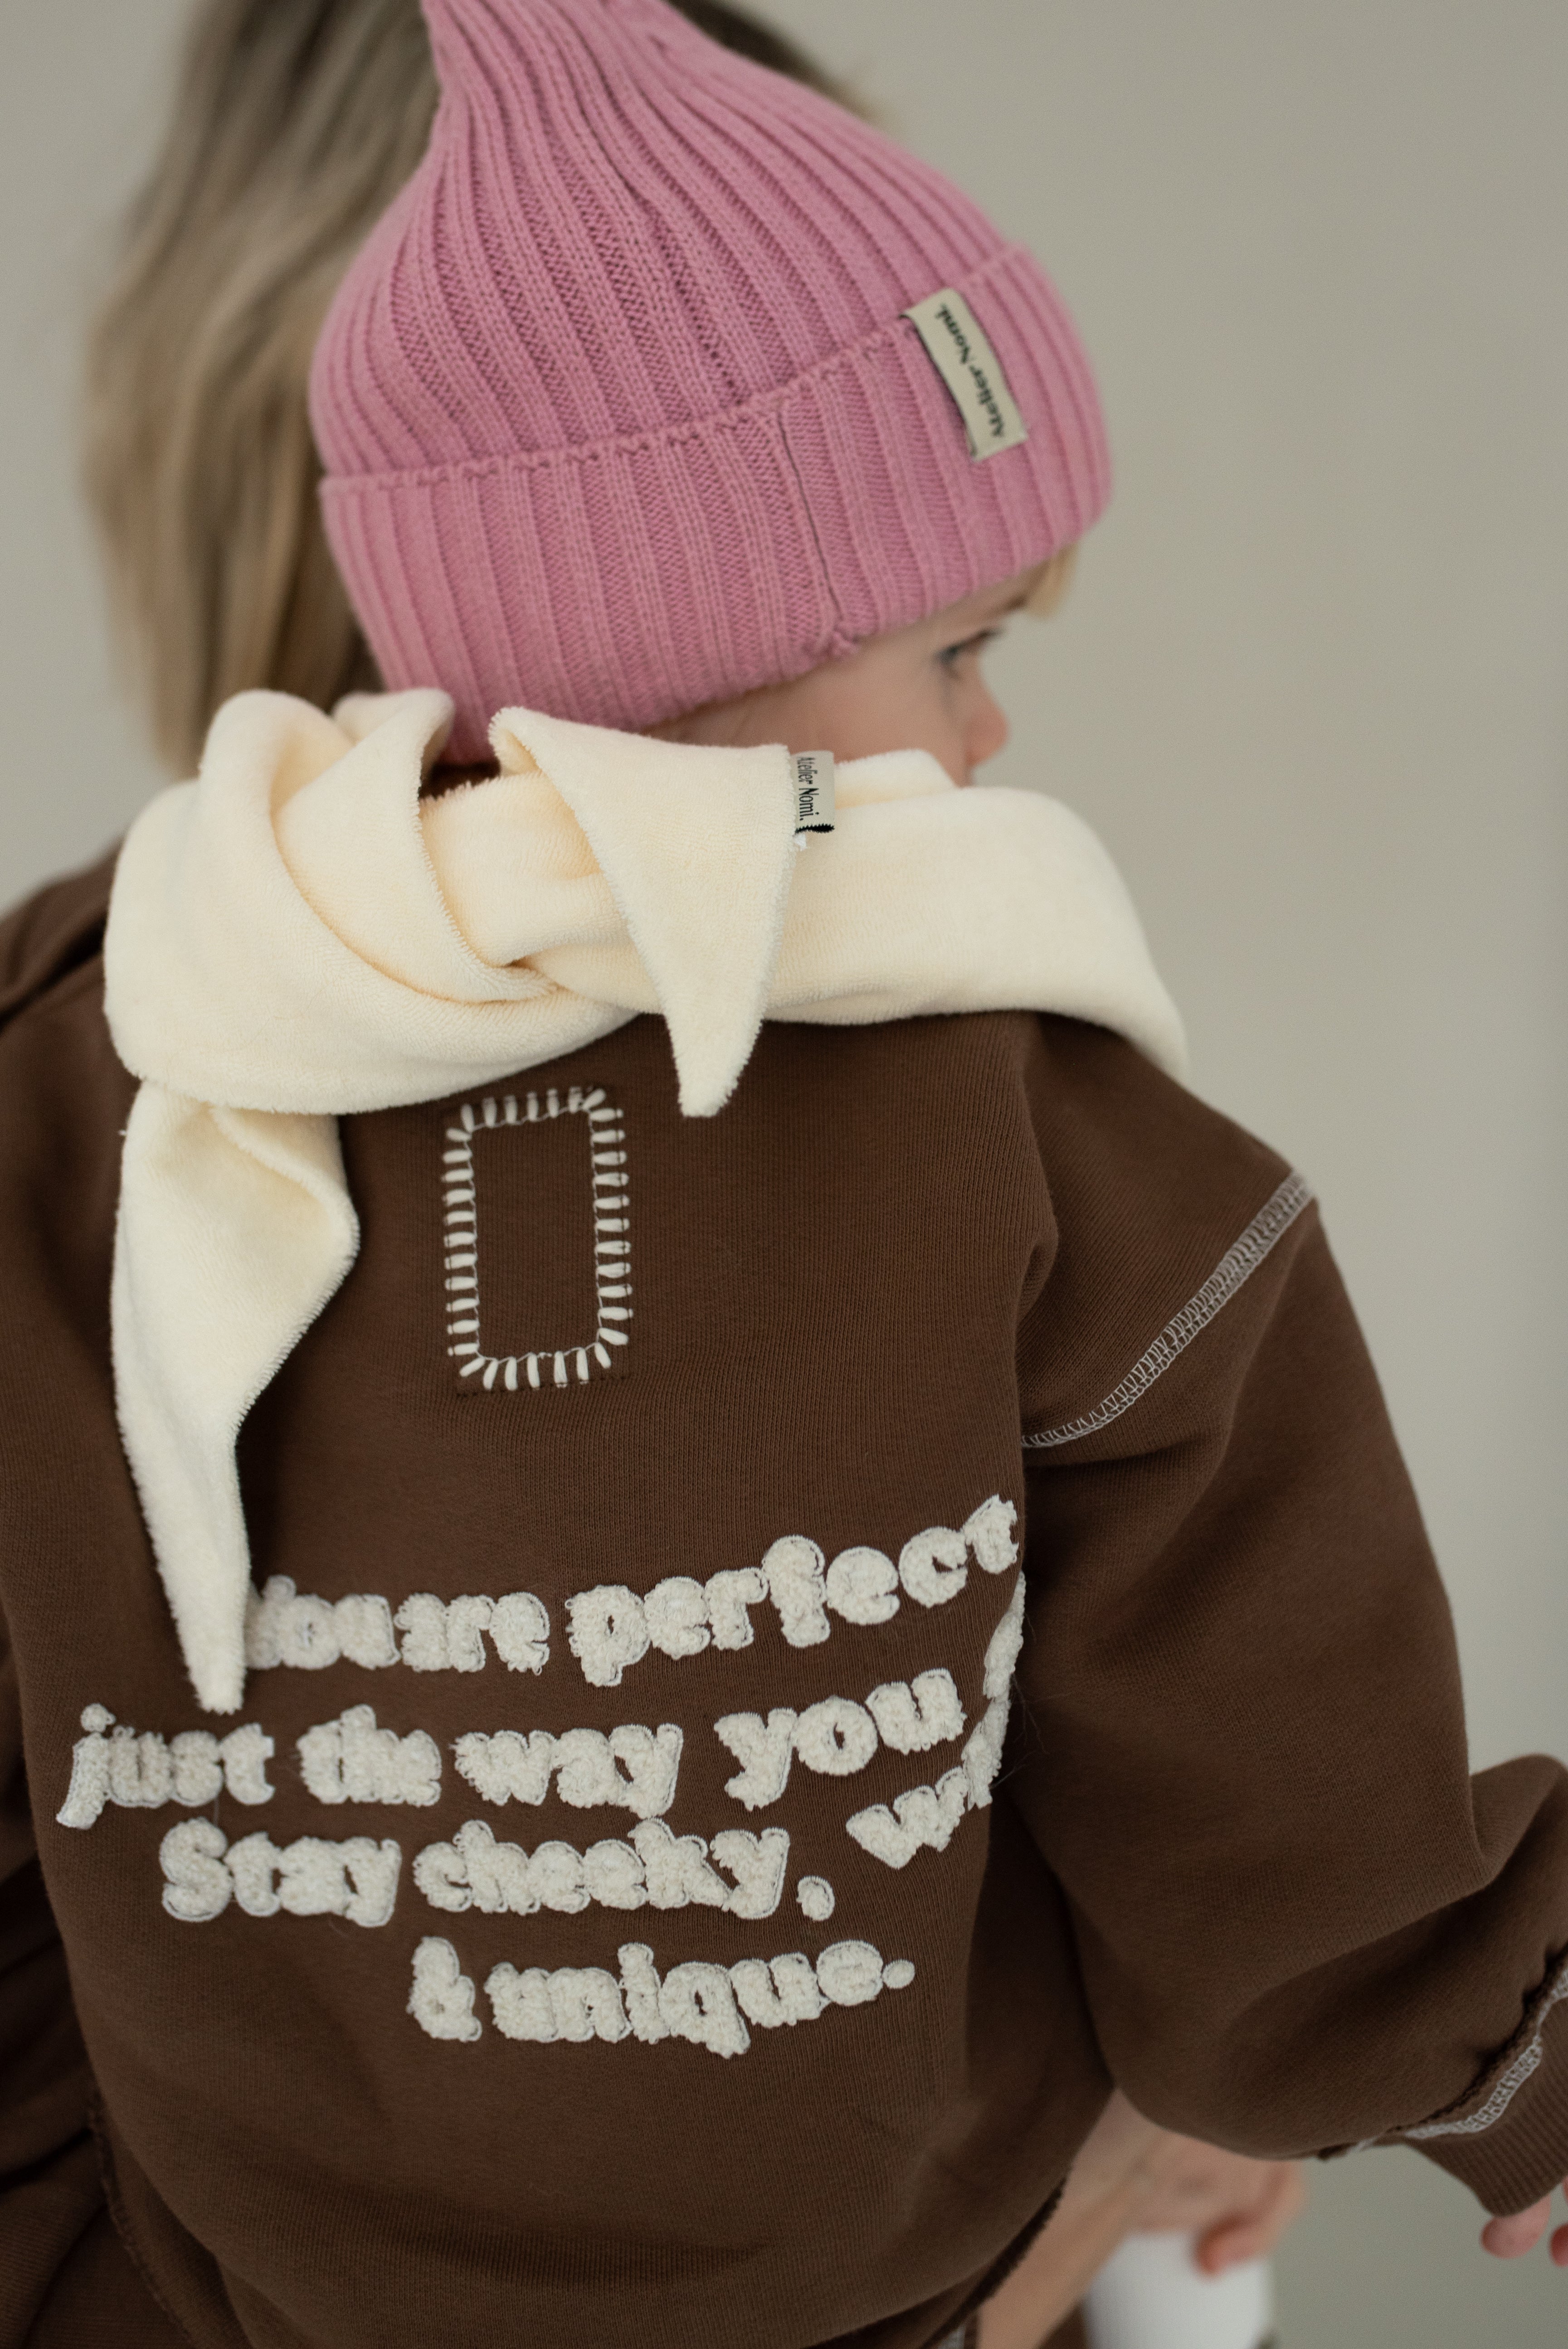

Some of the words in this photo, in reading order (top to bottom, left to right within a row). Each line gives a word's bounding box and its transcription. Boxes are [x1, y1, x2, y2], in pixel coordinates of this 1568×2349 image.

[968, 365, 1004, 438] Atelier
[797, 756, 818, 785] Atelier
[798, 787, 819, 821] Nomi.
[565, 1493, 1018, 1687] perfect
[56, 1703, 275, 1829] just
[450, 1723, 683, 1818] way
[713, 1668, 968, 1812] you
[159, 1817, 402, 1928] Stay
[413, 1818, 836, 1920] cheeky.
[484, 1939, 916, 2059] unique.
